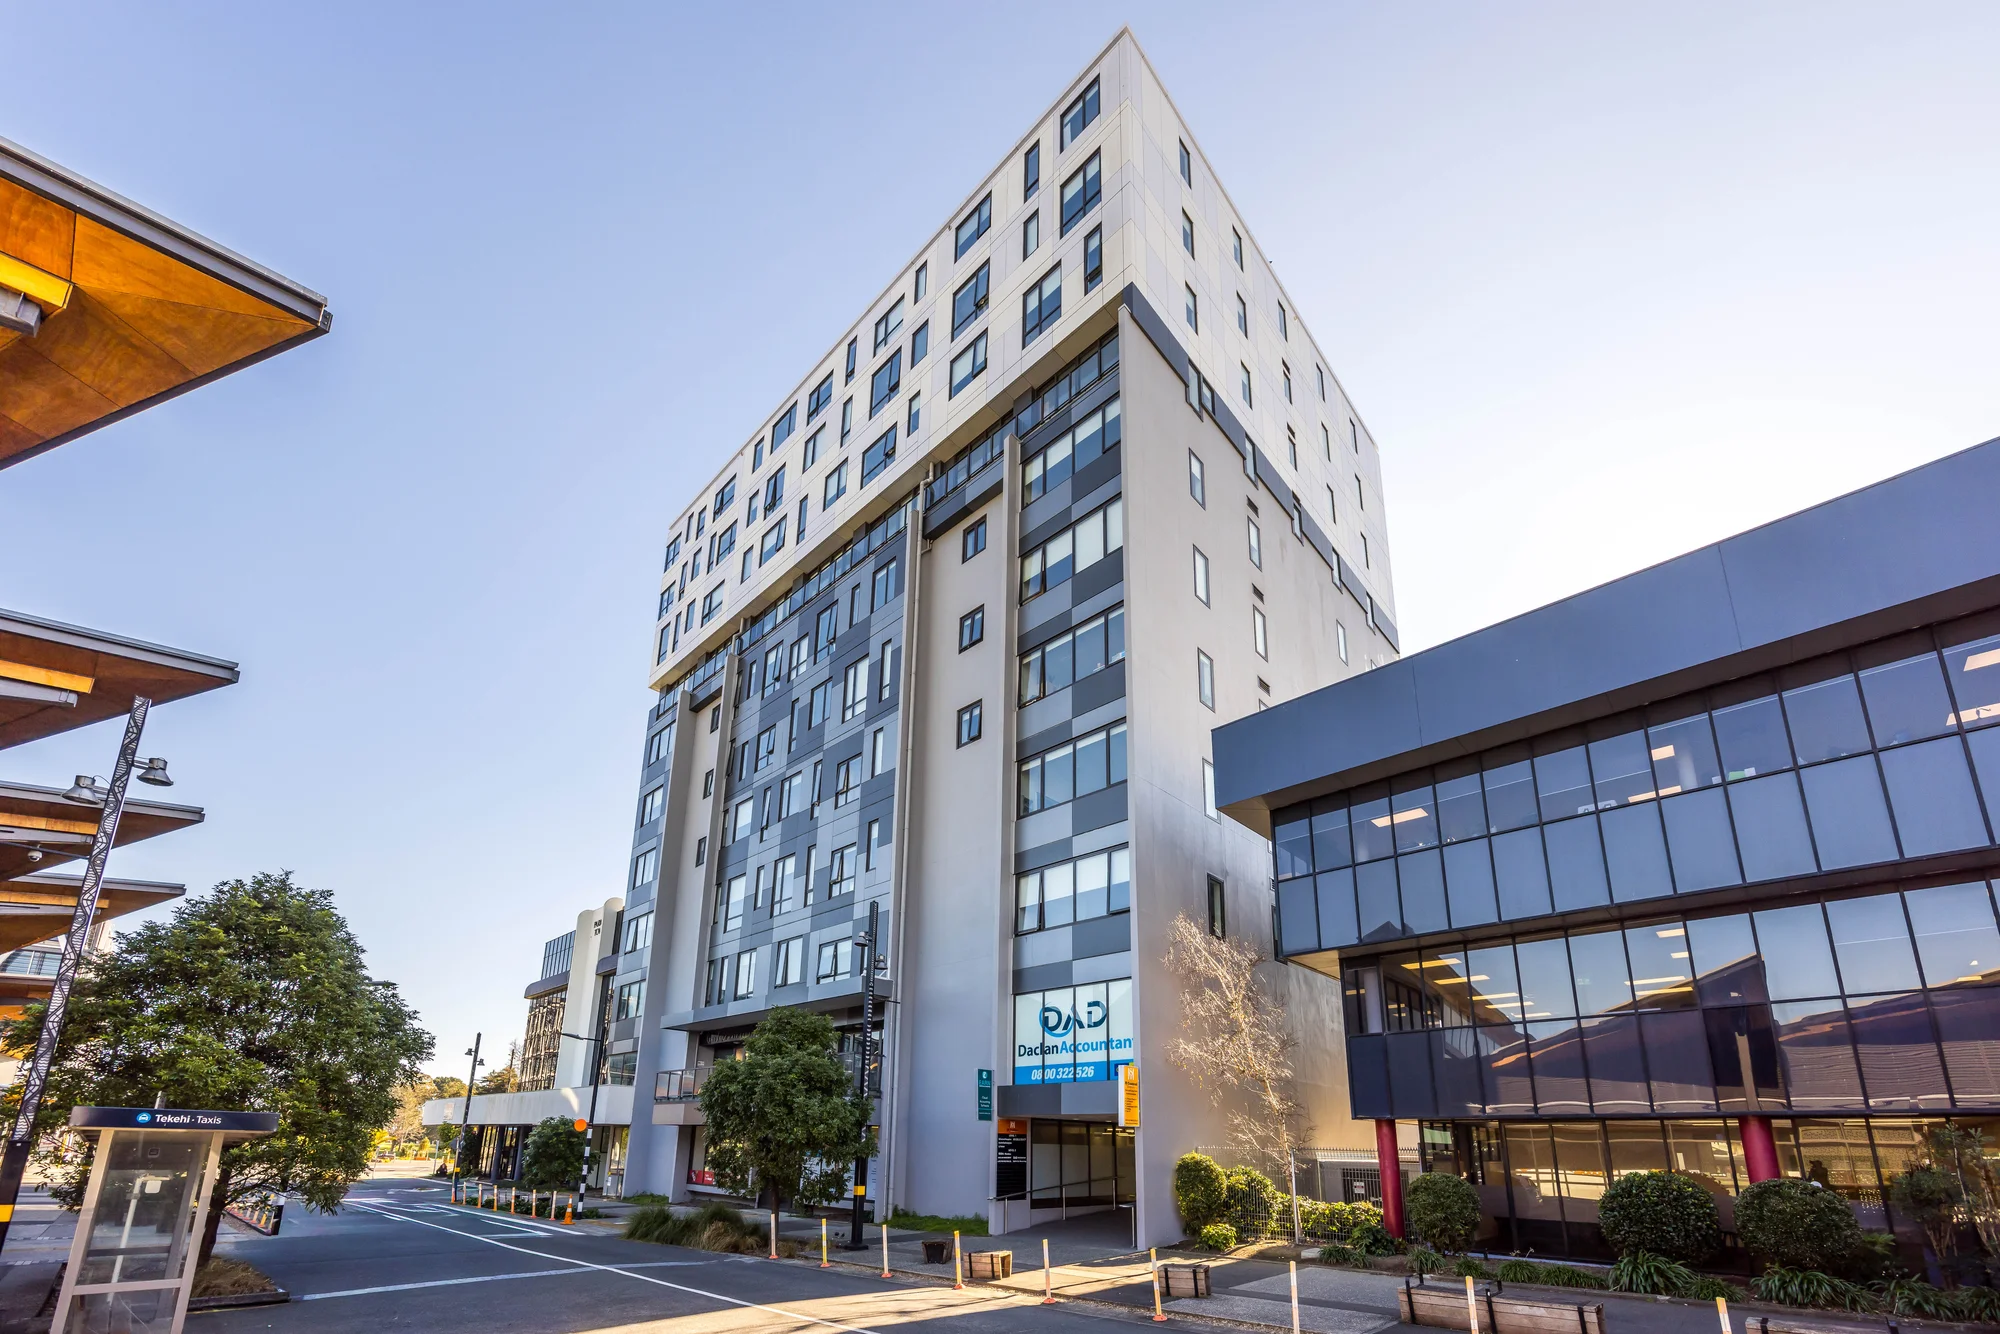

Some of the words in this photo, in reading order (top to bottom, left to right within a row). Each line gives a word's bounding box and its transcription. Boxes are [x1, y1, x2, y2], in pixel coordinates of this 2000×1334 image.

[1042, 1001, 1107, 1032] DAD
[1060, 1038, 1134, 1054] Accountan
[197, 1116, 222, 1125] Taxis
